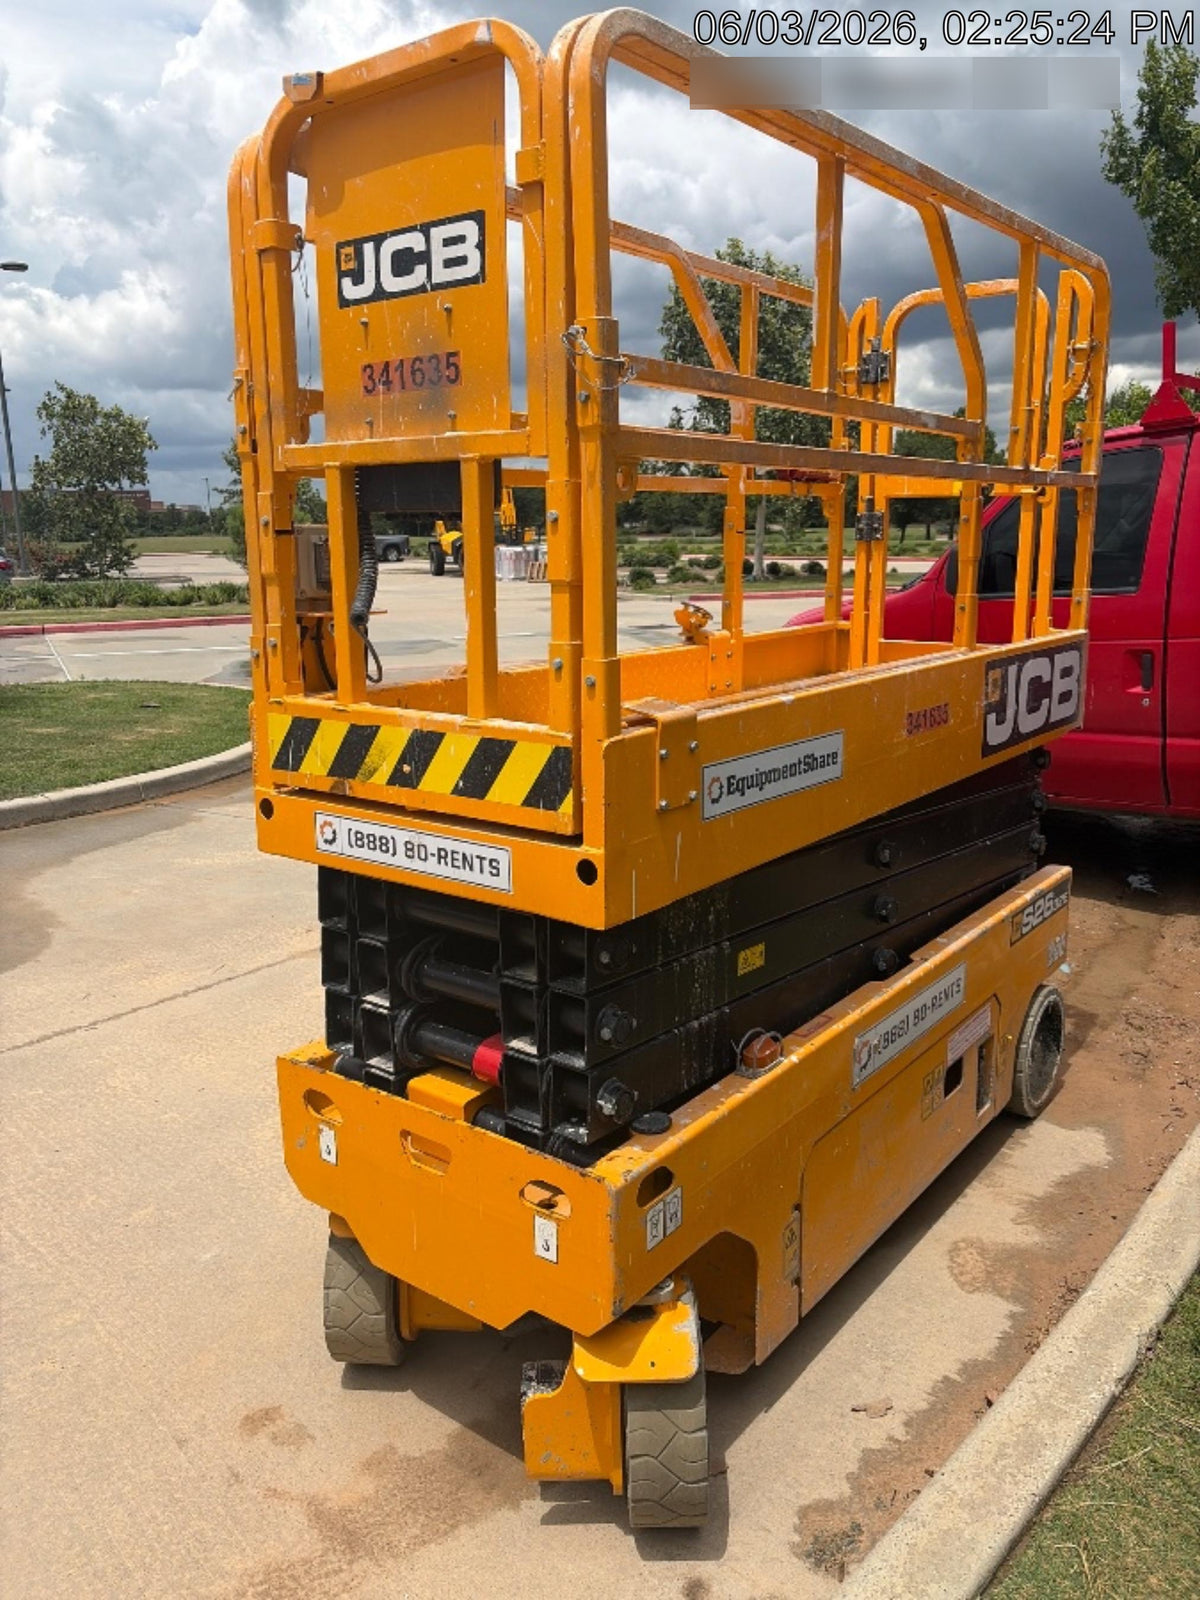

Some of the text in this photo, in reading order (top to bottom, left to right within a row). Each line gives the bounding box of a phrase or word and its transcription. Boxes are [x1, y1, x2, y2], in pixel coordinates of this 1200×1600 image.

[340, 219, 481, 300] JCB
[362, 351, 460, 394] 341635
[986, 650, 1080, 746] JCB
[726, 750, 839, 797] EquipmentShare
[347, 828, 501, 878] (888) 80-RENTS
